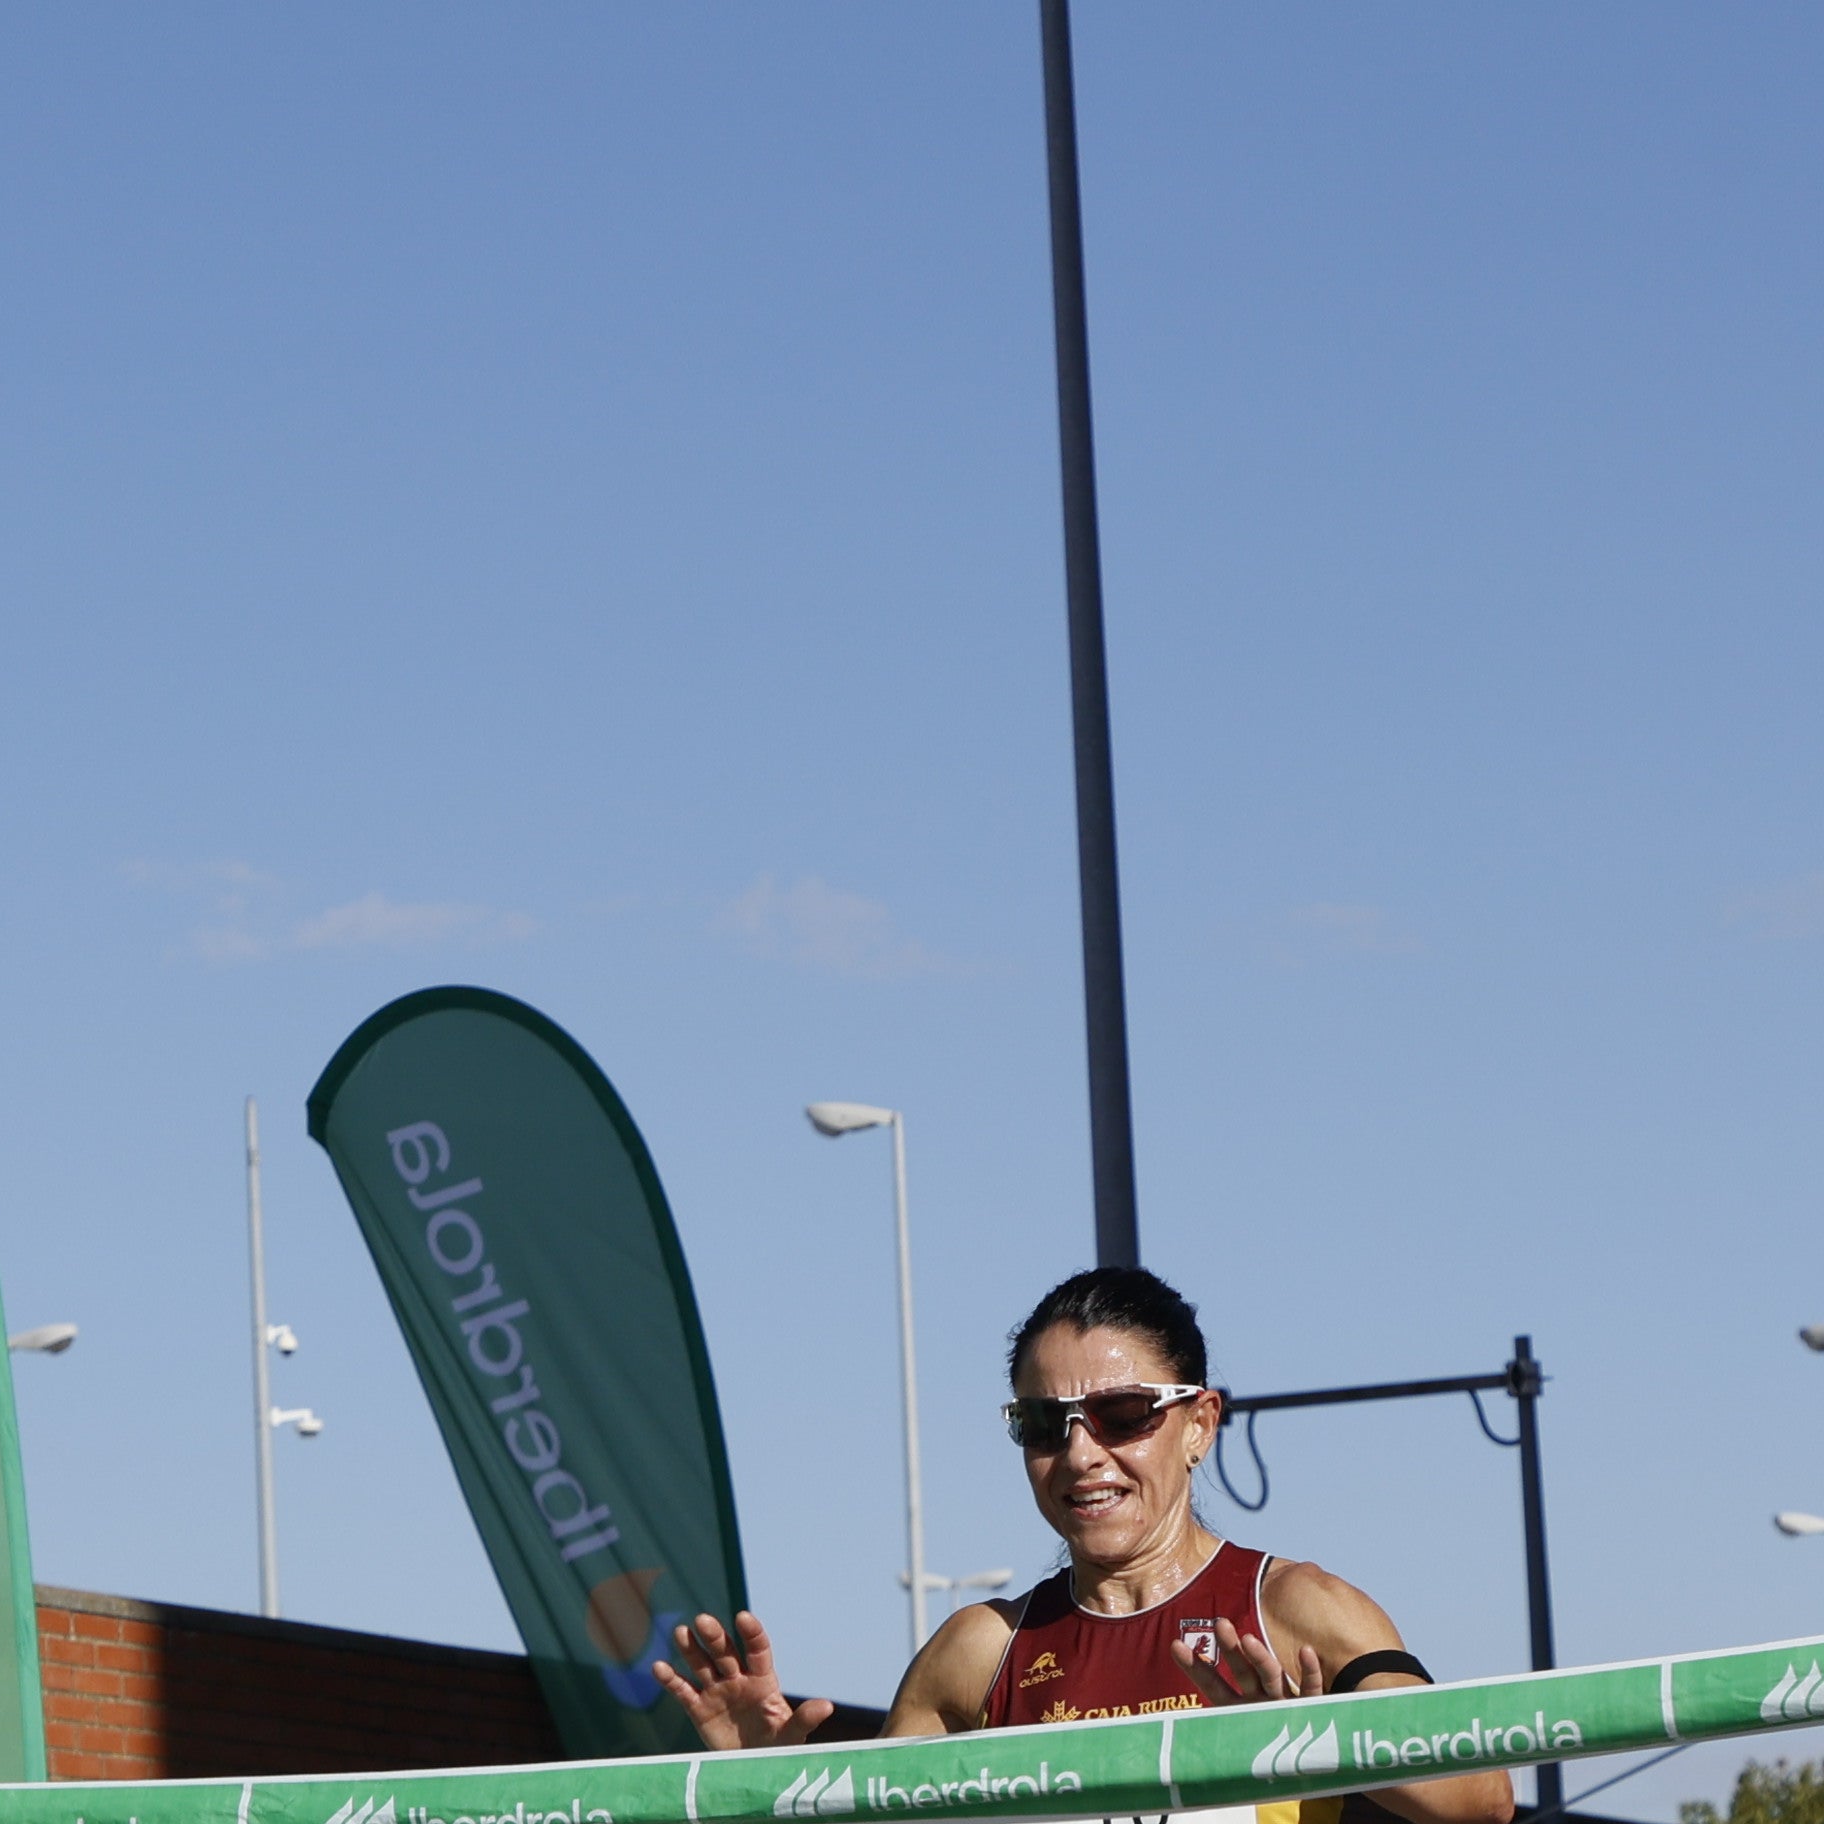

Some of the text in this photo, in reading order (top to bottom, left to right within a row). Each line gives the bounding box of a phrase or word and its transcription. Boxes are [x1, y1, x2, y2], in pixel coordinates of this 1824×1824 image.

[1139, 1693, 1203, 1714] RURAL
[1352, 1710, 1583, 1770] Iberdrola
[866, 1760, 1083, 1807] Iberdrola
